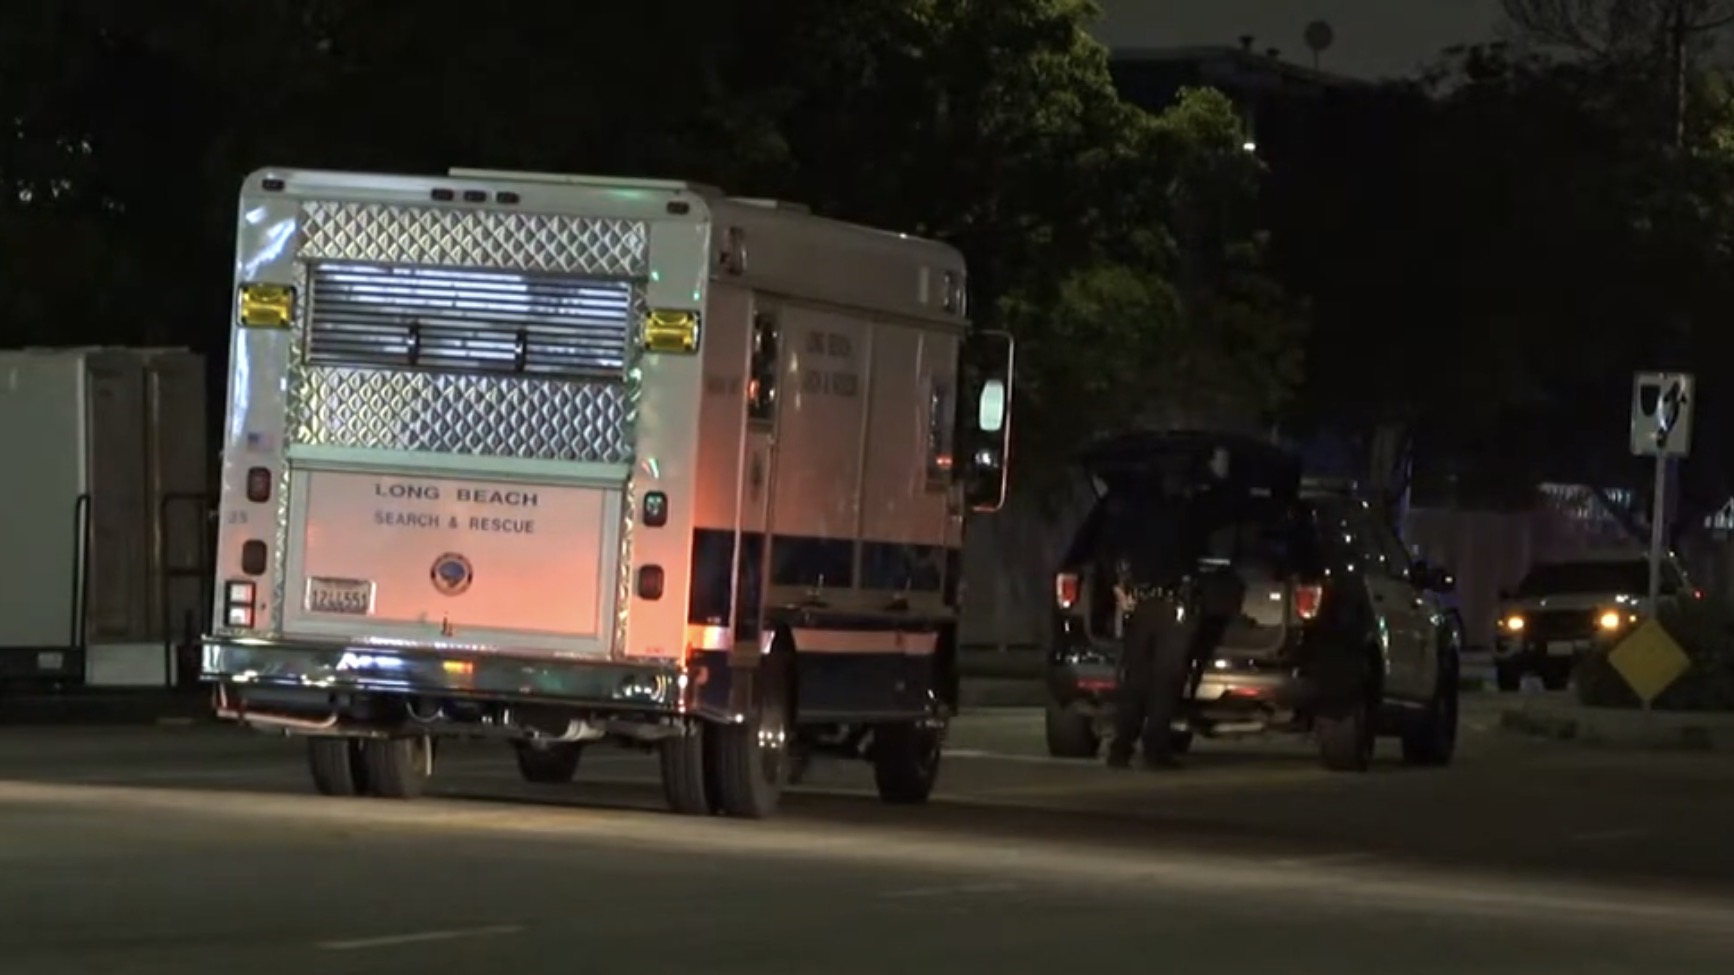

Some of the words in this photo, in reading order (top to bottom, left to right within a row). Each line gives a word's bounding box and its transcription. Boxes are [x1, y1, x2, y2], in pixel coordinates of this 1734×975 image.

[374, 482, 440, 501] LONG
[456, 486, 538, 507] BEACH
[374, 510, 440, 528] SEARCH
[448, 515, 459, 528] &
[469, 516, 535, 534] RESCUE
